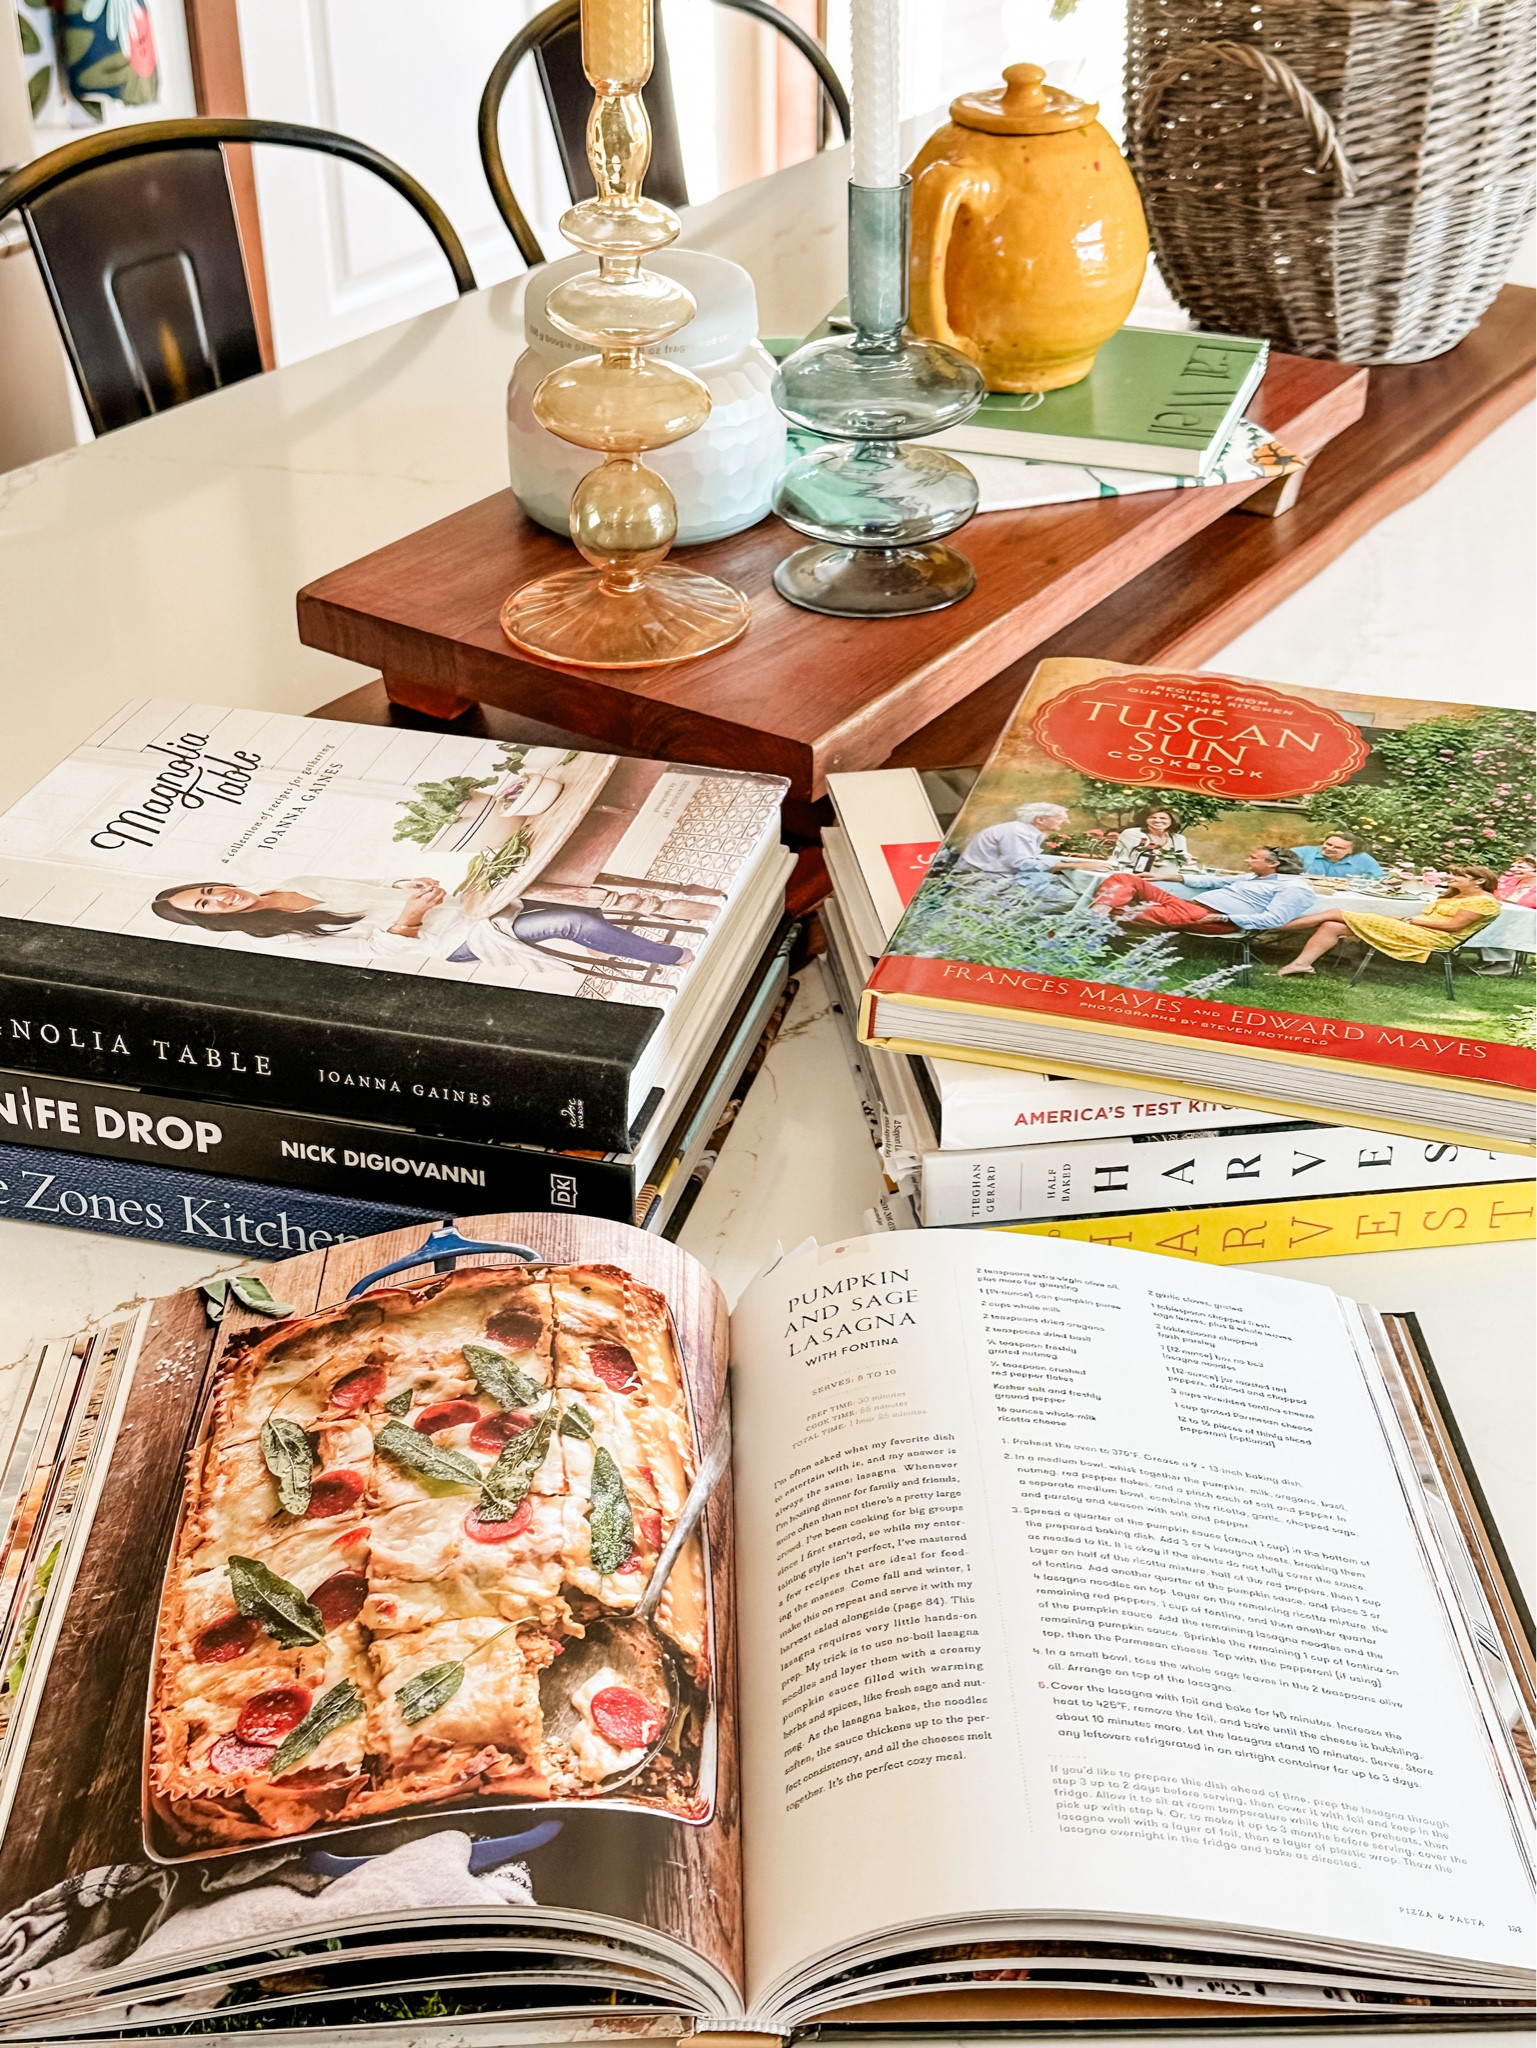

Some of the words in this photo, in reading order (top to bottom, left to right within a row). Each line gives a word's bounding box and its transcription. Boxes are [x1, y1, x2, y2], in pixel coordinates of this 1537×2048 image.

[1127, 687, 1161, 697] OUR
[1164, 691, 1223, 706] ITALIAN
[1227, 700, 1294, 716] KITCHEN
[1155, 684, 1222, 700] RECIPES
[1225, 695, 1270, 706] FROM
[1181, 704, 1225, 717] THE
[1081, 700, 1323, 753] TUSCAN
[1127, 731, 1249, 766] SUN
[181, 750, 262, 809] Table
[1107, 750, 1264, 779] COOKBOOK
[90, 731, 210, 850] Magnolia
[227, 820, 263, 857] collection
[261, 811, 272, 822] of
[268, 785, 293, 813] recipes
[292, 776, 304, 789] for
[302, 744, 336, 775] gathering
[258, 804, 307, 851] JOANNA
[301, 762, 344, 802] GAINES
[943, 965, 1070, 995] FRANCES
[1079, 986, 1182, 1013] MAYES
[1193, 1008, 1221, 1017] AND
[1230, 1010, 1365, 1041] EDWARD
[1377, 1031, 1488, 1060] MAYES
[1079, 1002, 1176, 1023] PHOTOGRAPHS
[1181, 1017, 1198, 1025] BY
[1201, 1022, 1255, 1035] STEVEN
[1257, 1030, 1329, 1046] ROTHFELD
[0, 1019, 130, 1056] NOLIA
[153, 1039, 272, 1076] TABLE
[318, 1069, 401, 1093] JOANNA
[412, 1084, 492, 1107] GAINES
[1014, 1105, 1125, 1126] AMERICA'S
[1132, 1101, 1182, 1118] TEST
[94, 1105, 223, 1154] DROP
[280, 1140, 337, 1165] NICK
[344, 1149, 486, 1187] DIGIOVANNI
[1093, 1143, 1497, 1193] HARVES
[21, 1170, 165, 1229] Zones
[971, 1163, 982, 1218] TIEGHAN
[986, 1165, 996, 1213] GERARD
[1047, 1168, 1057, 1199] HALF
[1062, 1163, 1072, 1202] BAKED
[788, 1268, 910, 1313] PUMPKIN
[784, 1304, 840, 1339] AND
[851, 1289, 920, 1312] SAGE
[789, 1312, 917, 1357] LASAGNA
[805, 1349, 838, 1367] WITH
[842, 1337, 899, 1355] FONTINA
[867, 1370, 882, 1380] TO
